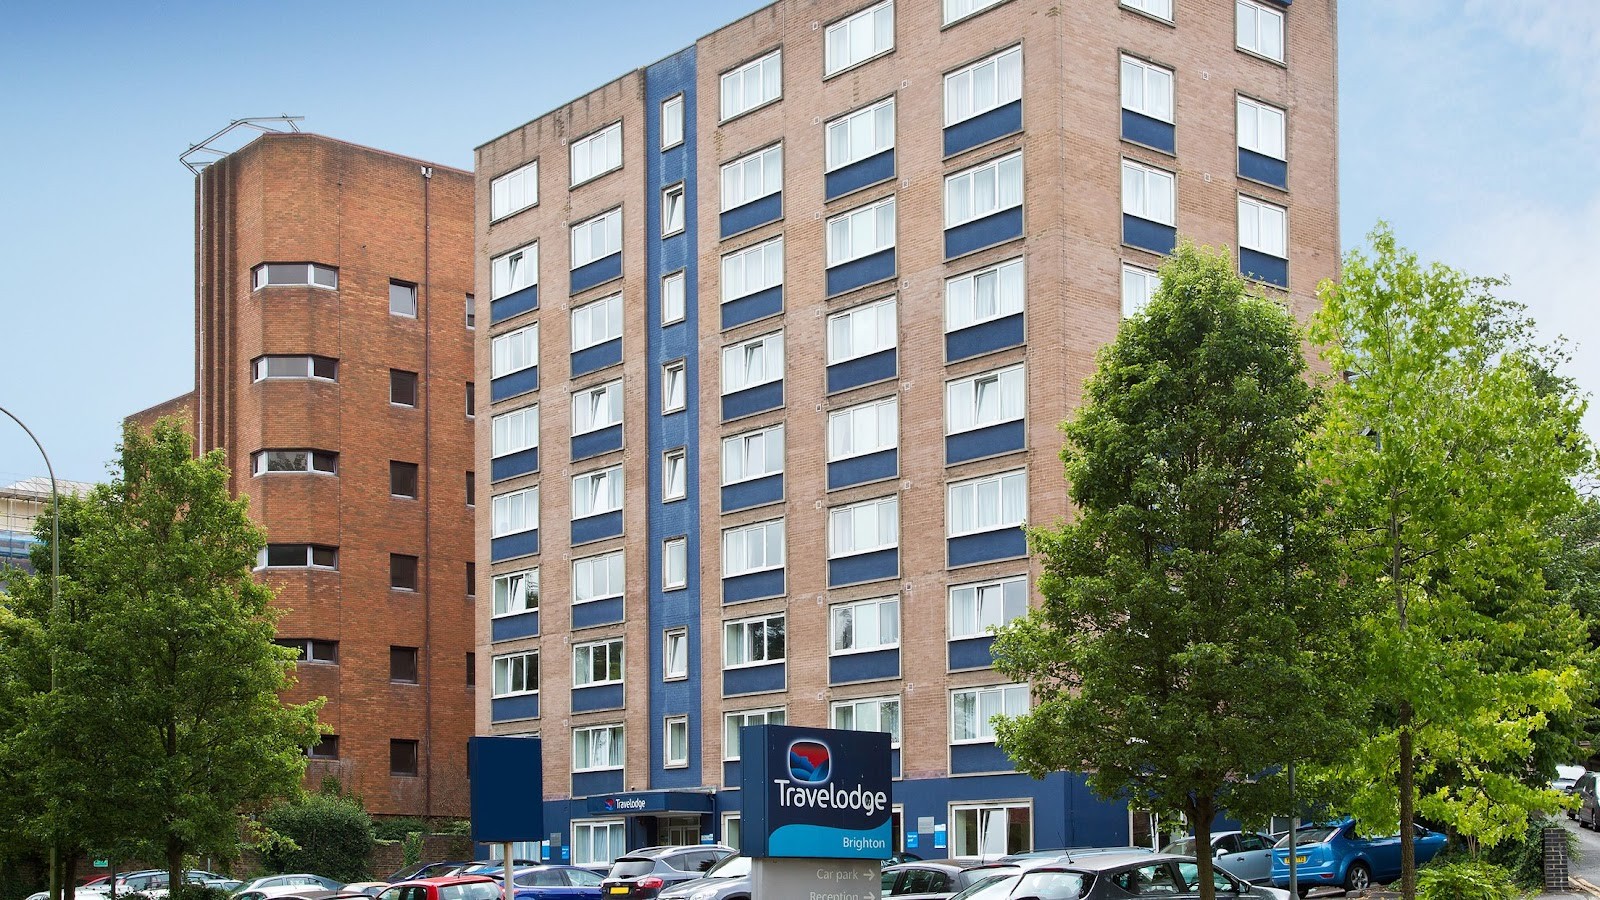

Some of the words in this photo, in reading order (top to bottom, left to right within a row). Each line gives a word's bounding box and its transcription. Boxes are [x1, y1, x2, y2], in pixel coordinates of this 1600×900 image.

[615, 798, 646, 810] Travelodge
[774, 779, 887, 816] Travelodge
[843, 837, 886, 851] Brighton
[816, 868, 834, 880] Car
[836, 868, 859, 883] park
